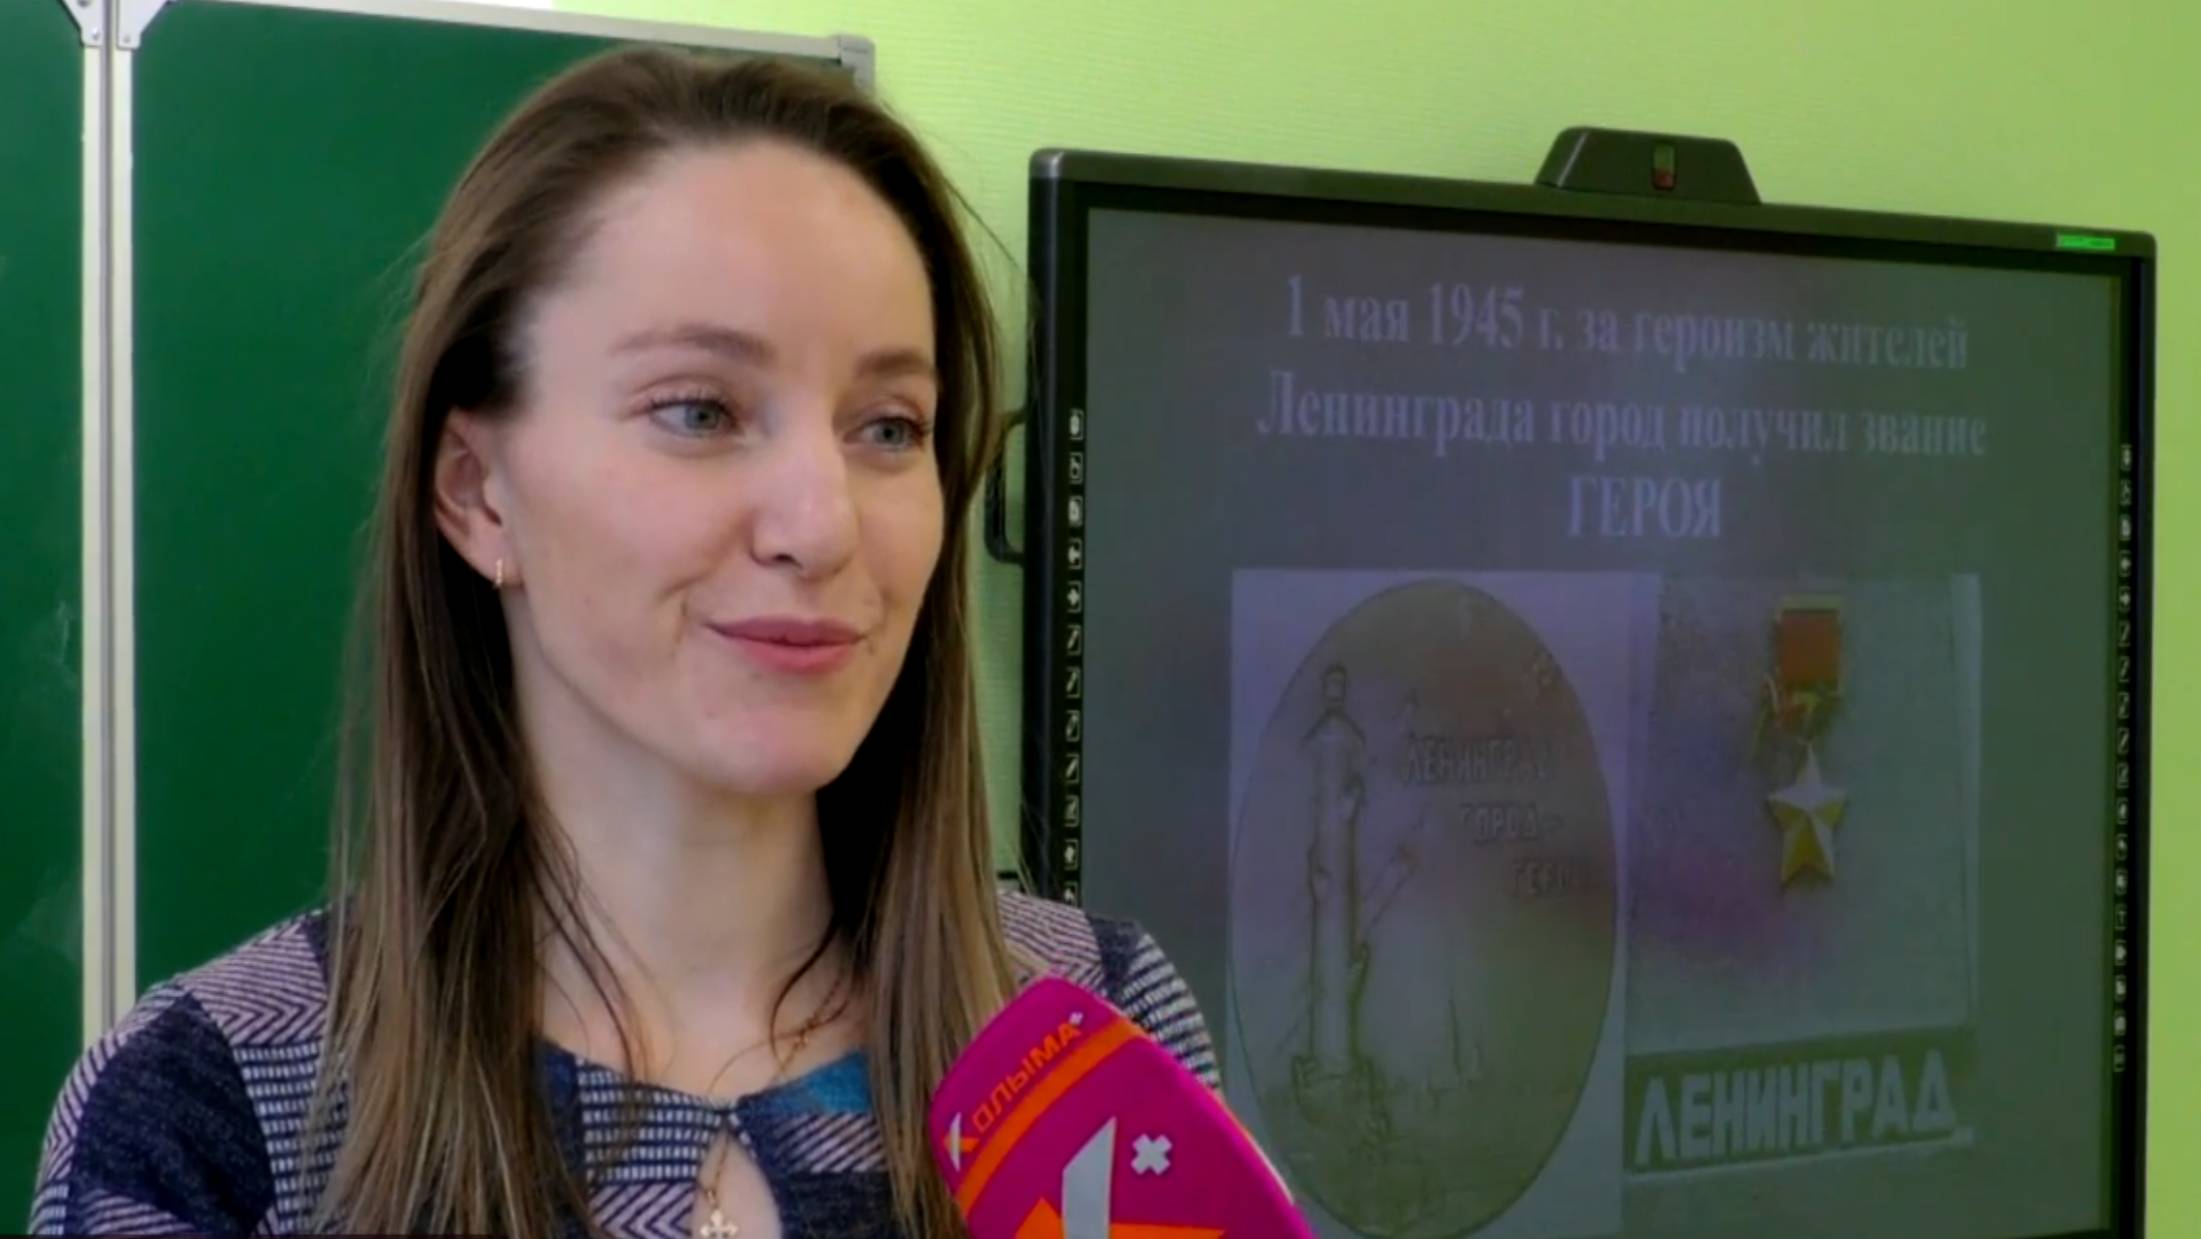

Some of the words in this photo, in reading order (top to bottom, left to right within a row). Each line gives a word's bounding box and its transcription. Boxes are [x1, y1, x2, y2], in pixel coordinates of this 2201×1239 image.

[1286, 273, 1305, 337] 1
[1321, 293, 1410, 344] мая
[1428, 281, 1526, 350] 1945
[1538, 307, 1564, 352] г.
[1576, 307, 1622, 352] за
[1633, 312, 1795, 374] героизм
[1806, 317, 1970, 369] жителей
[1256, 368, 1536, 457] Ленинграда
[1549, 400, 1666, 462] город
[1679, 404, 1850, 465] получил
[1861, 413, 1988, 457] звание
[1566, 475, 1723, 539] ГЕРОЯ
[1633, 1048, 1958, 1166] ЛЕНИНГРАД
